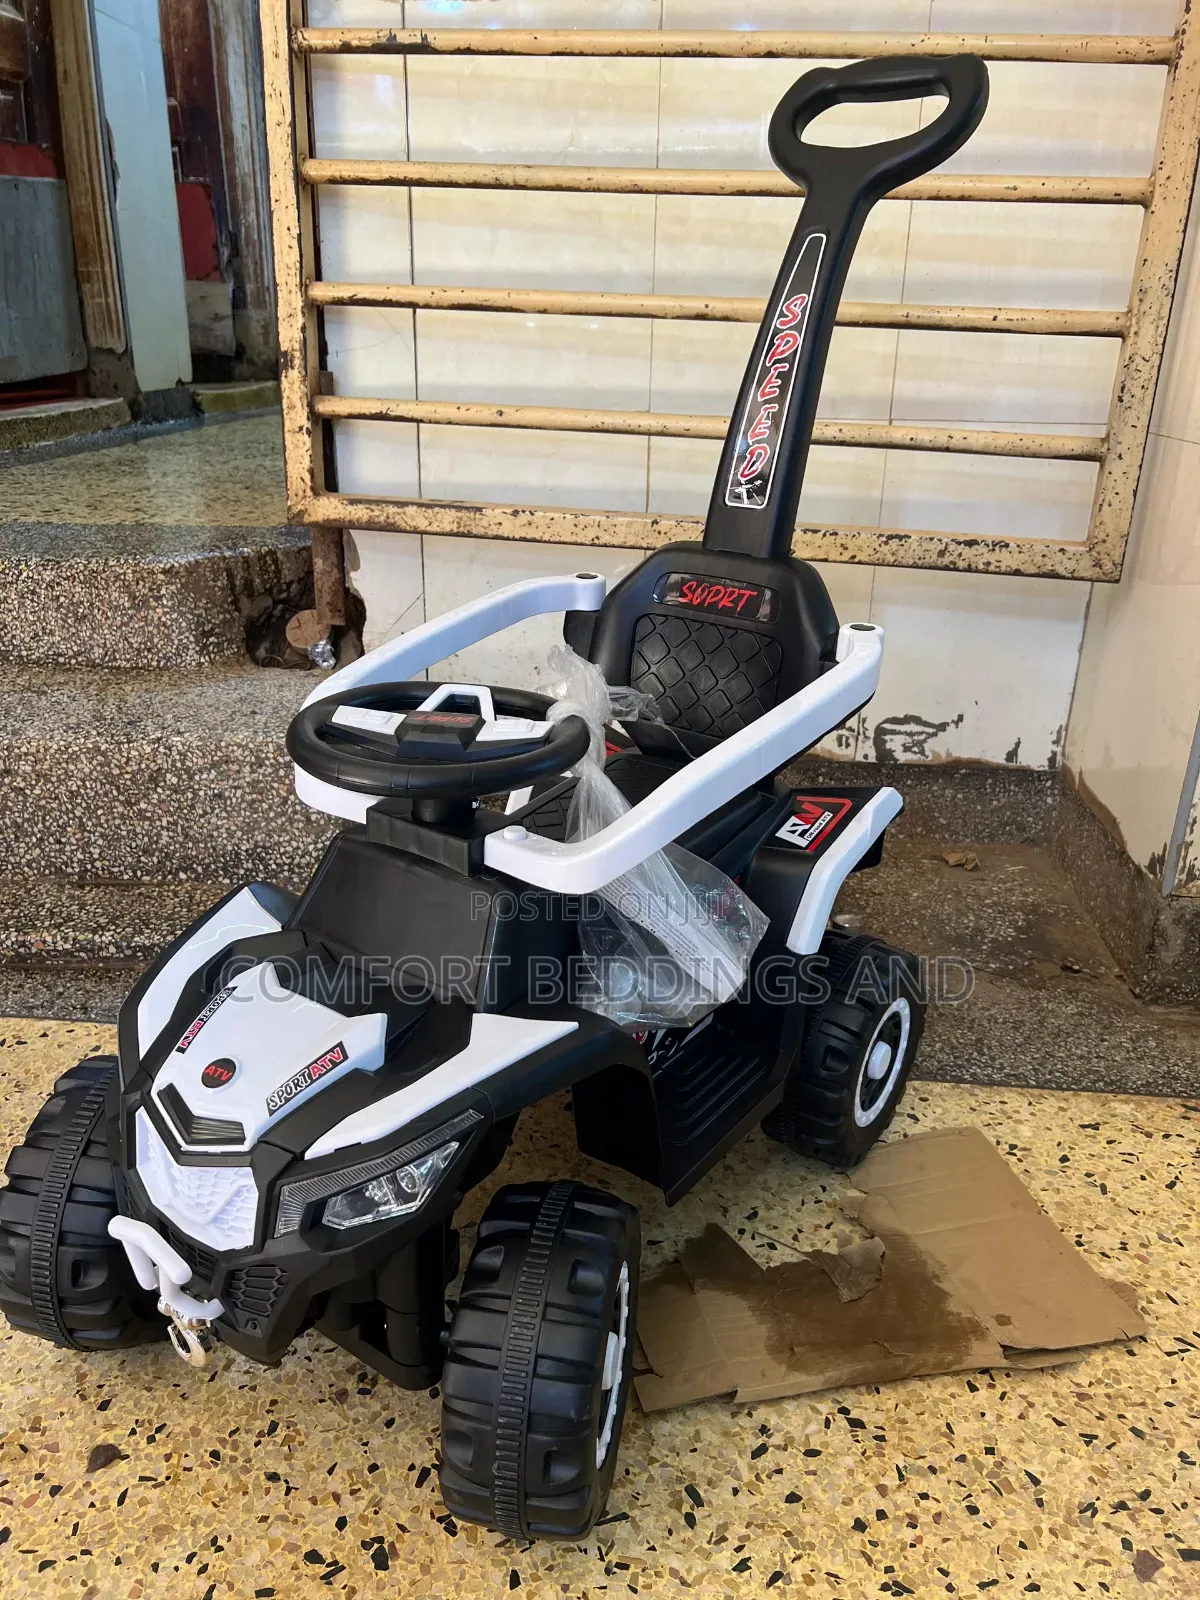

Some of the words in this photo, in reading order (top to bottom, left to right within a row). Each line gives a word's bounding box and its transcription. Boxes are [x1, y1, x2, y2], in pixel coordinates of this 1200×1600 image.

[738, 293, 808, 480] SPEED
[204, 1065, 234, 1081] ATV
[268, 1070, 311, 1109] SPORT
[309, 1047, 344, 1080] ATV
